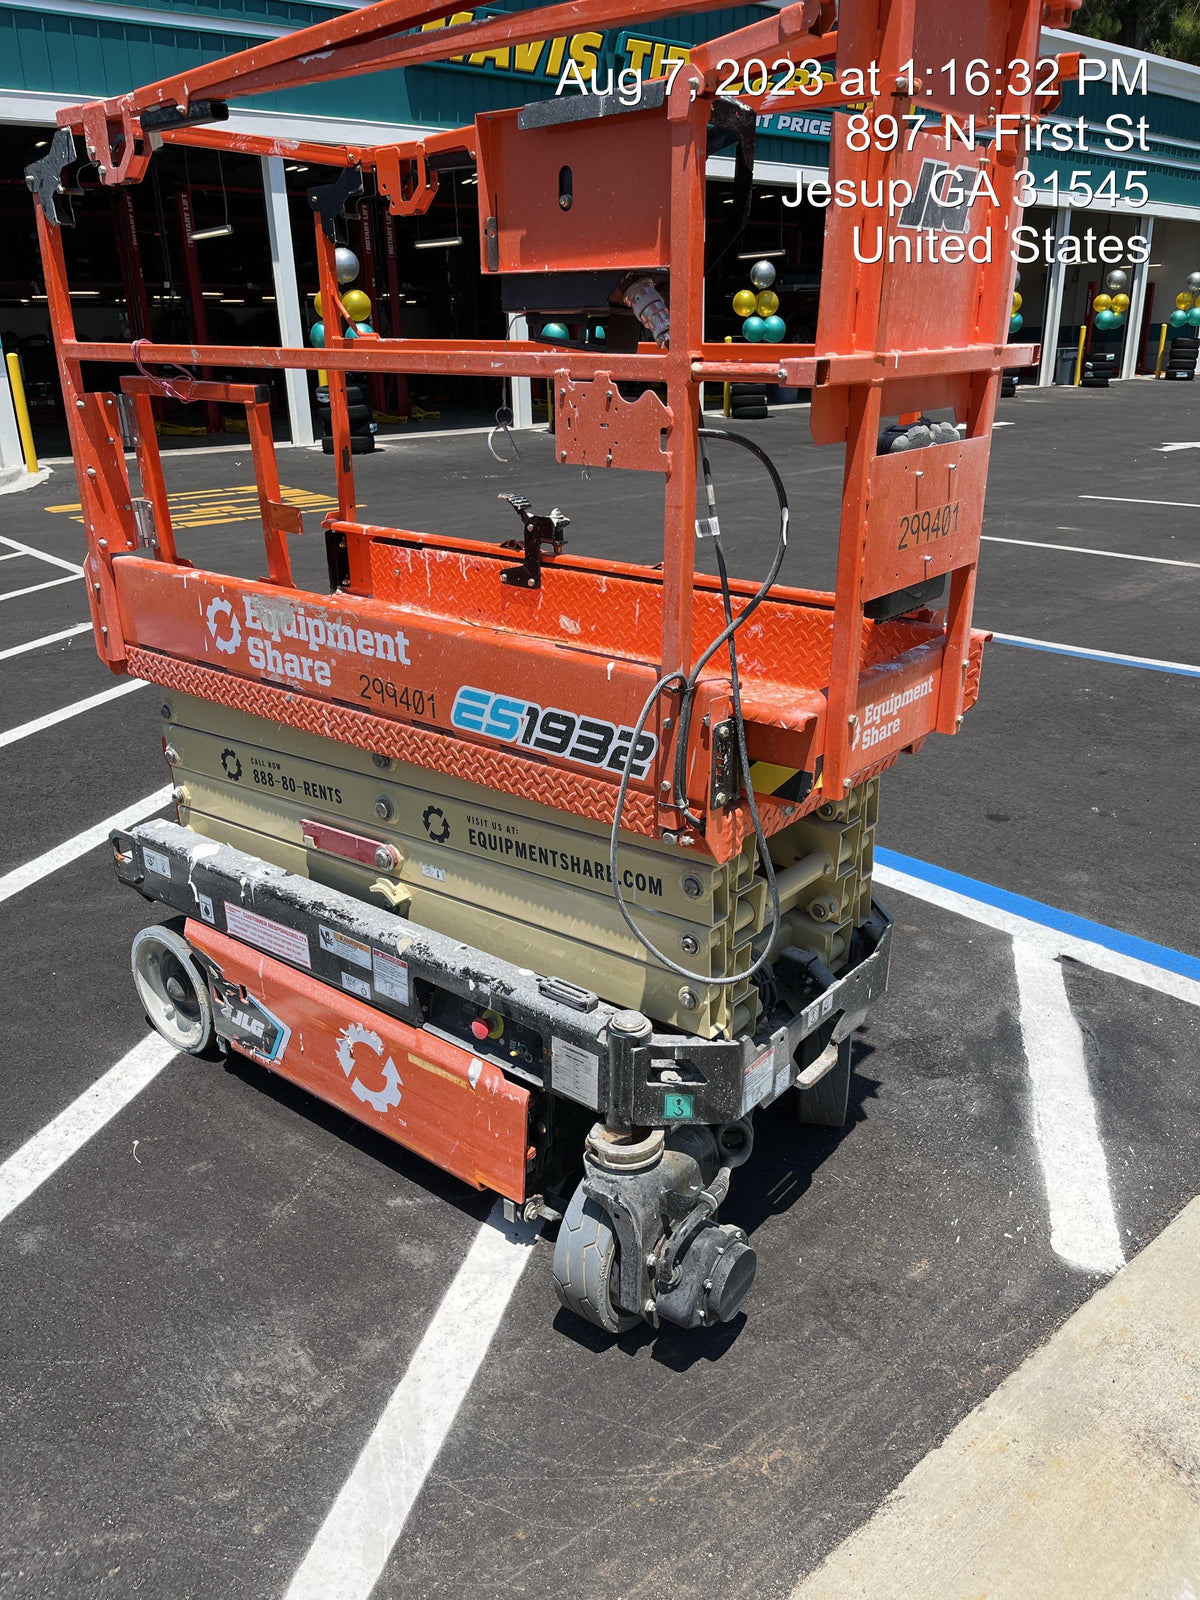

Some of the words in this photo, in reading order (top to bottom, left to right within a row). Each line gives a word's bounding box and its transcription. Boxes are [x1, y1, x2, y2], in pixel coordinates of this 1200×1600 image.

[777, 114, 833, 136] PRICE
[897, 501, 960, 551] 299401
[242, 596, 412, 666] Equipment
[247, 636, 332, 687] Share
[359, 674, 436, 720] 299401
[863, 674, 934, 726] Equipment
[451, 686, 658, 780] ES1932
[861, 717, 901, 751] Share
[250, 757, 266, 768] CALL
[268, 761, 281, 770] NOW
[252, 768, 343, 804] 888-80-RENTS
[466, 815, 488, 828] VISIT
[491, 821, 503, 831] US
[506, 825, 519, 835] AT:
[468, 828, 663, 897] EQUIPMENTSHARE.COM
[231, 1010, 265, 1039] JLG
